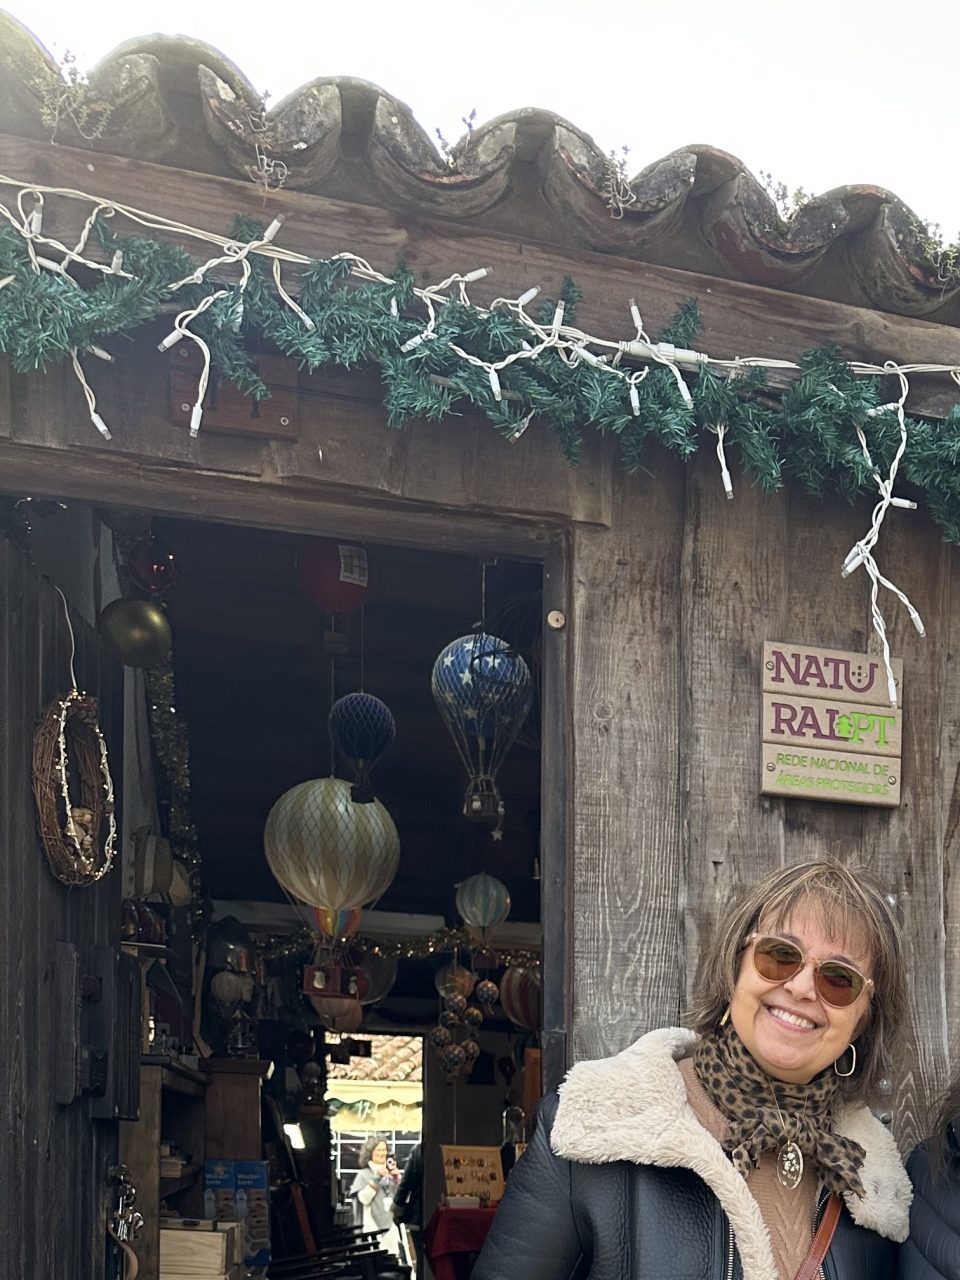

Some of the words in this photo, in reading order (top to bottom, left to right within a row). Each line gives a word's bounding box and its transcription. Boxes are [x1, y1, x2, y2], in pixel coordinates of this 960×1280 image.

[771, 650, 879, 693] NATU
[777, 753, 808, 767] REDE
[810, 756, 871, 774] NACIONAL
[873, 763, 889, 776] DE
[815, 777, 890, 795] PROTEGIDAS
